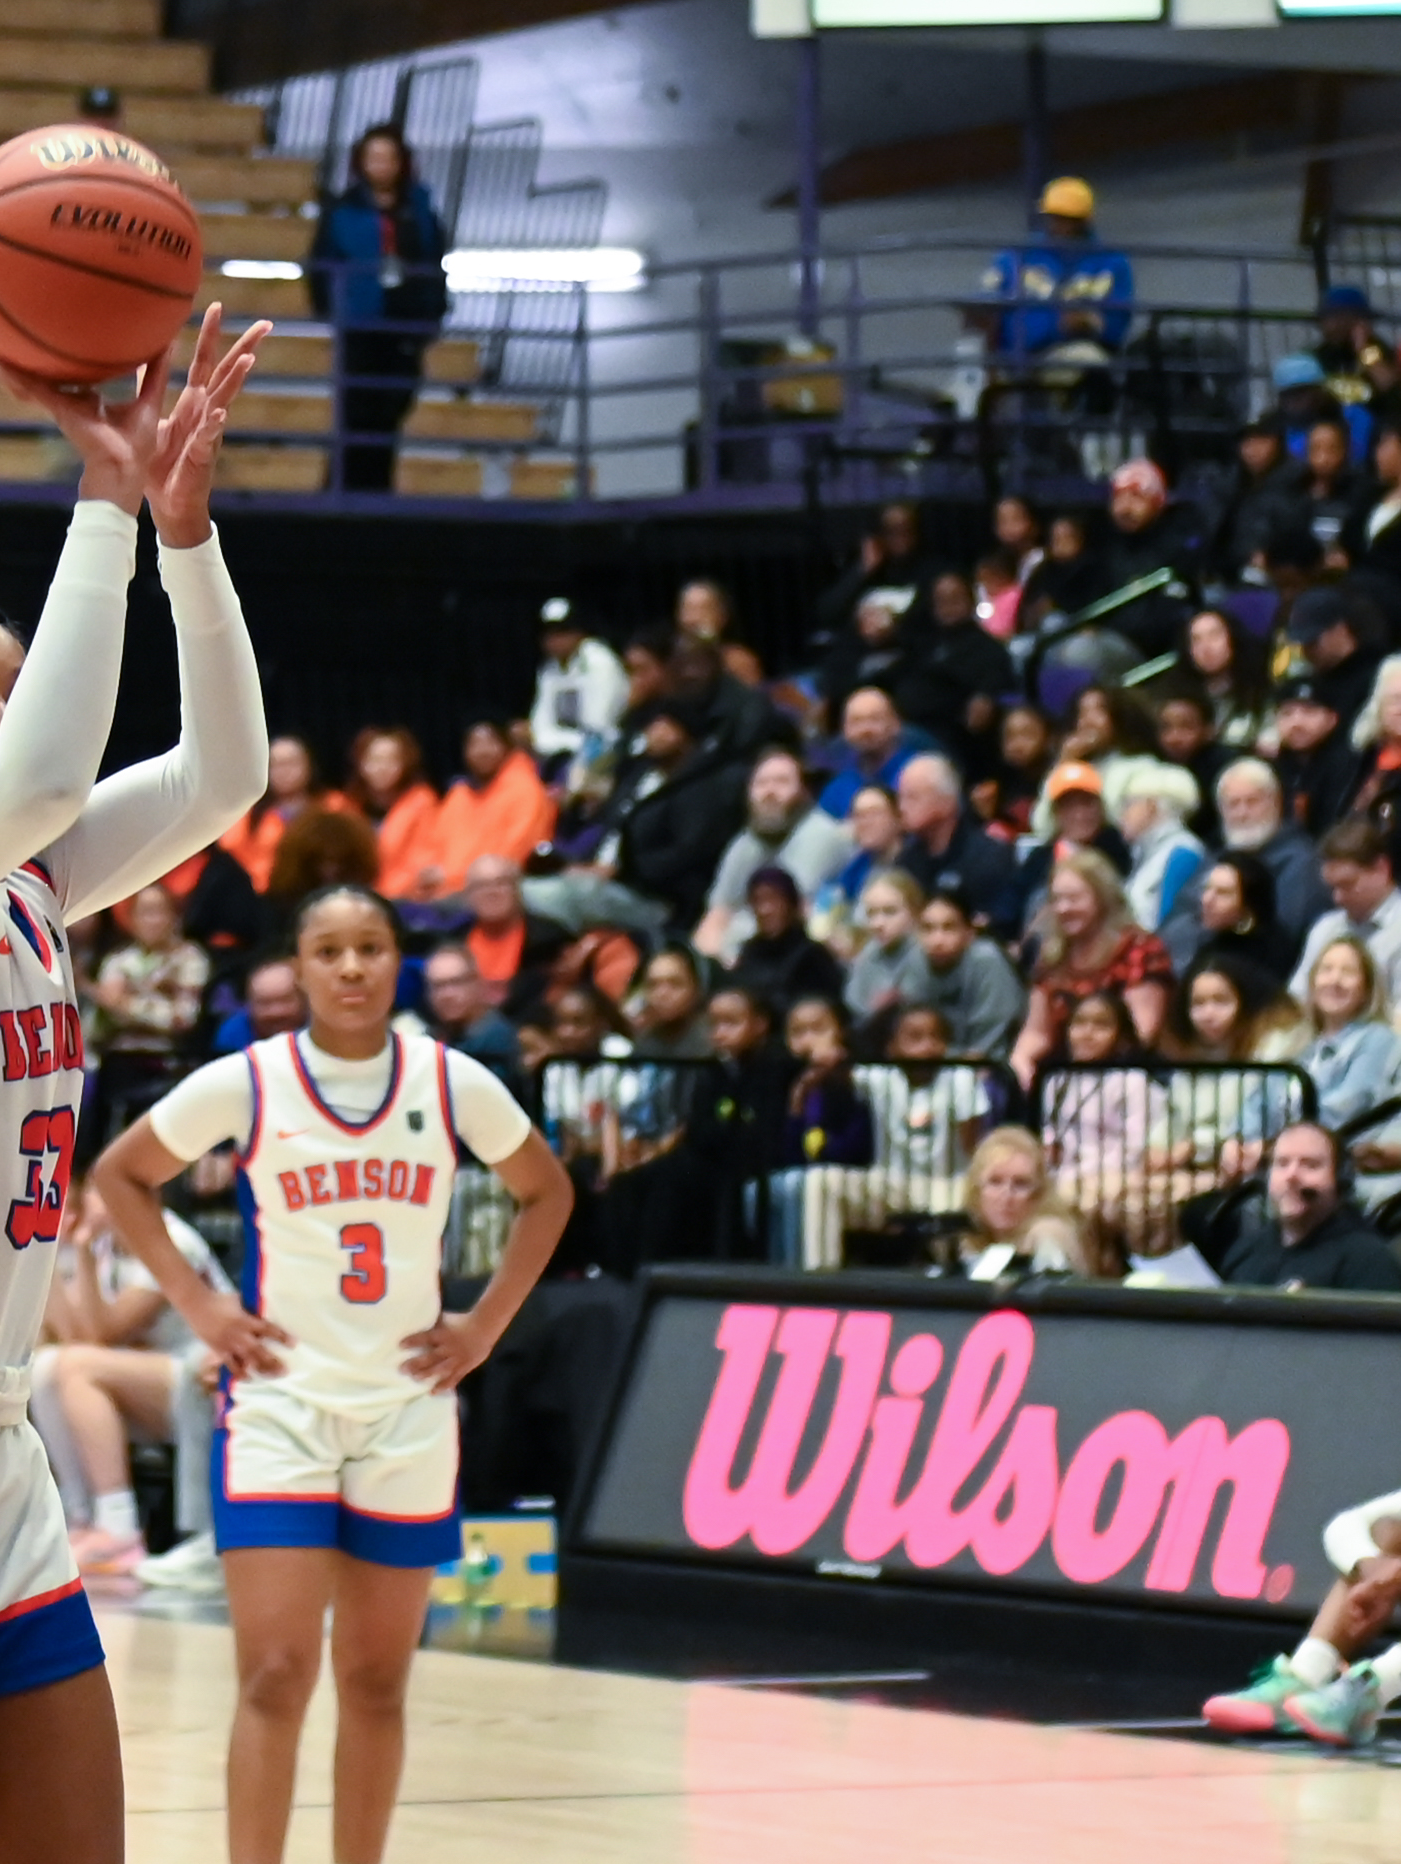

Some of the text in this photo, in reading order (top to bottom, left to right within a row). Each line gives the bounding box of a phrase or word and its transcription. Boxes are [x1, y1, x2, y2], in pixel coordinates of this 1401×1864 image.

[278, 1158, 437, 1213] BENSON
[339, 1221, 388, 1304] 3
[683, 1303, 1291, 1602] Wilson
